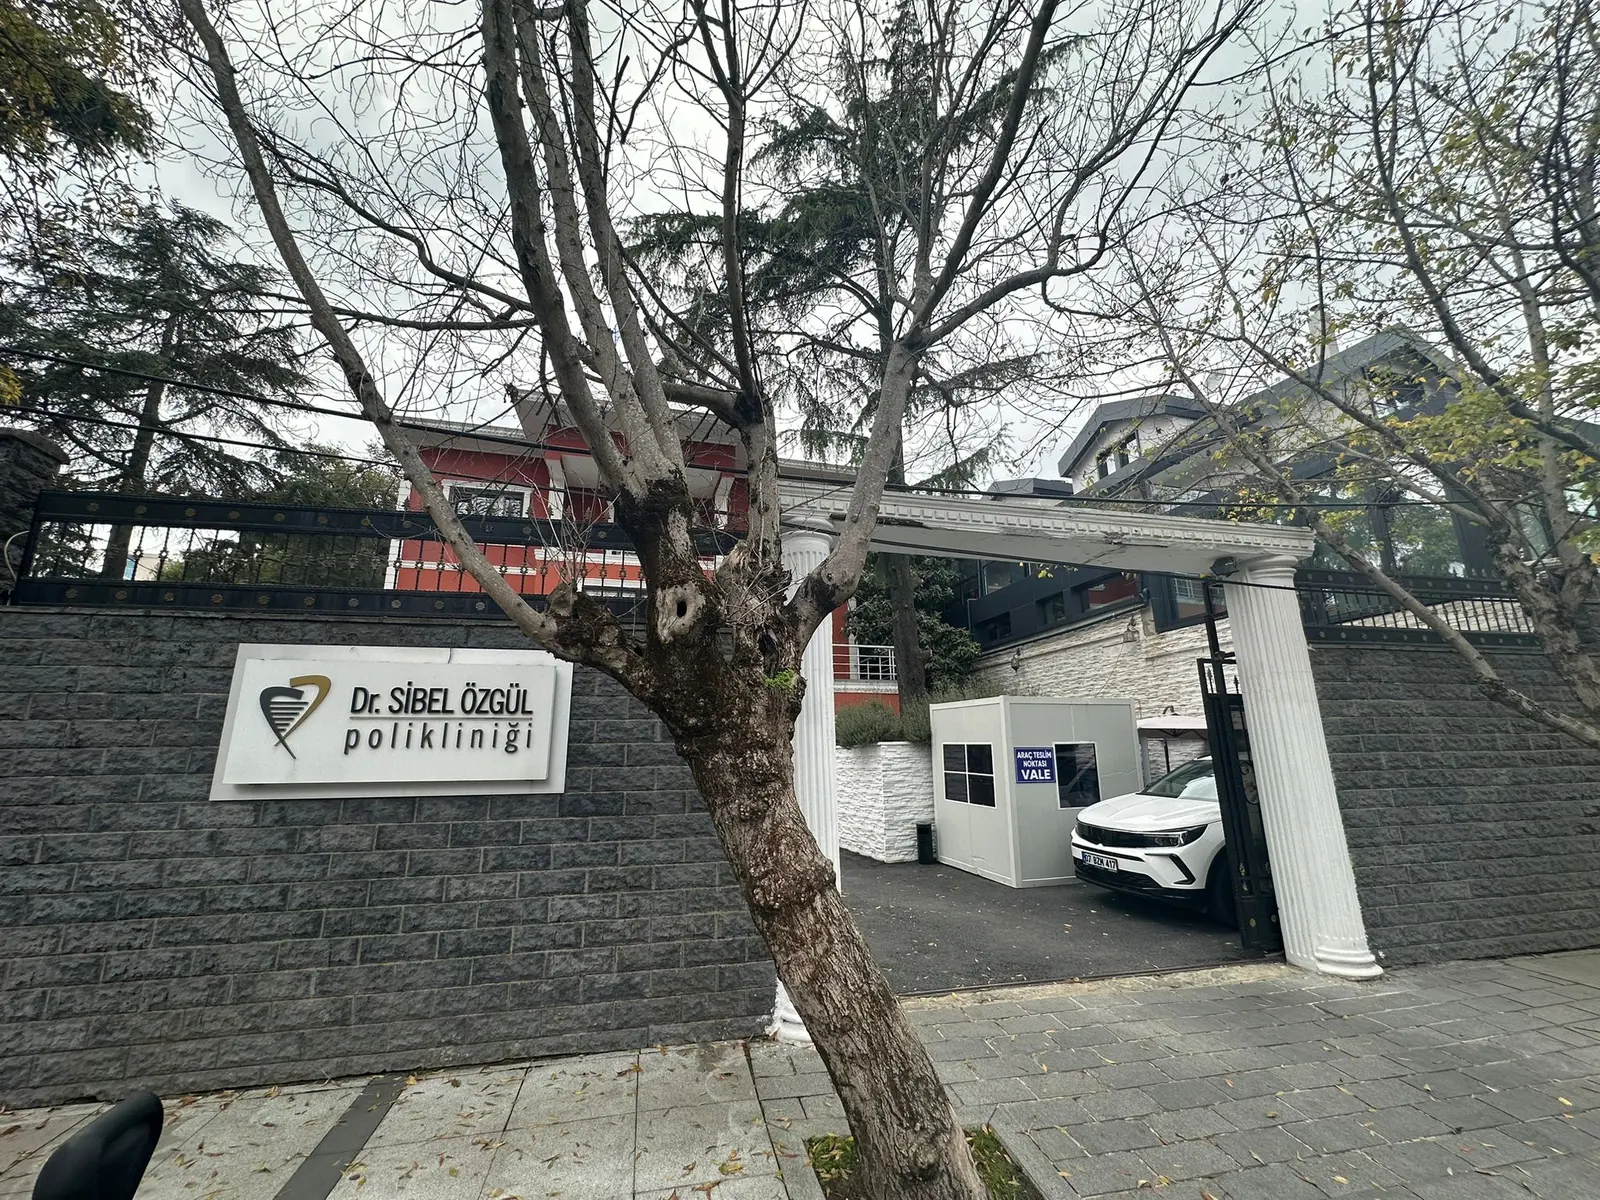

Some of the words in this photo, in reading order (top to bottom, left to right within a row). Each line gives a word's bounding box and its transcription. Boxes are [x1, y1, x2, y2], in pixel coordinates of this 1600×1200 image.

[350, 686, 381, 714] Dr.
[387, 681, 454, 714] SİBEL
[460, 682, 533, 715] ÖZGÜL
[344, 722, 532, 755] polikliniği
[1016, 751, 1033, 760] ARAÇ
[1033, 750, 1052, 759] TESLİM
[1023, 760, 1047, 768] NOKTASI
[1021, 769, 1051, 780] VALE
[1106, 859, 1116, 869] 417
